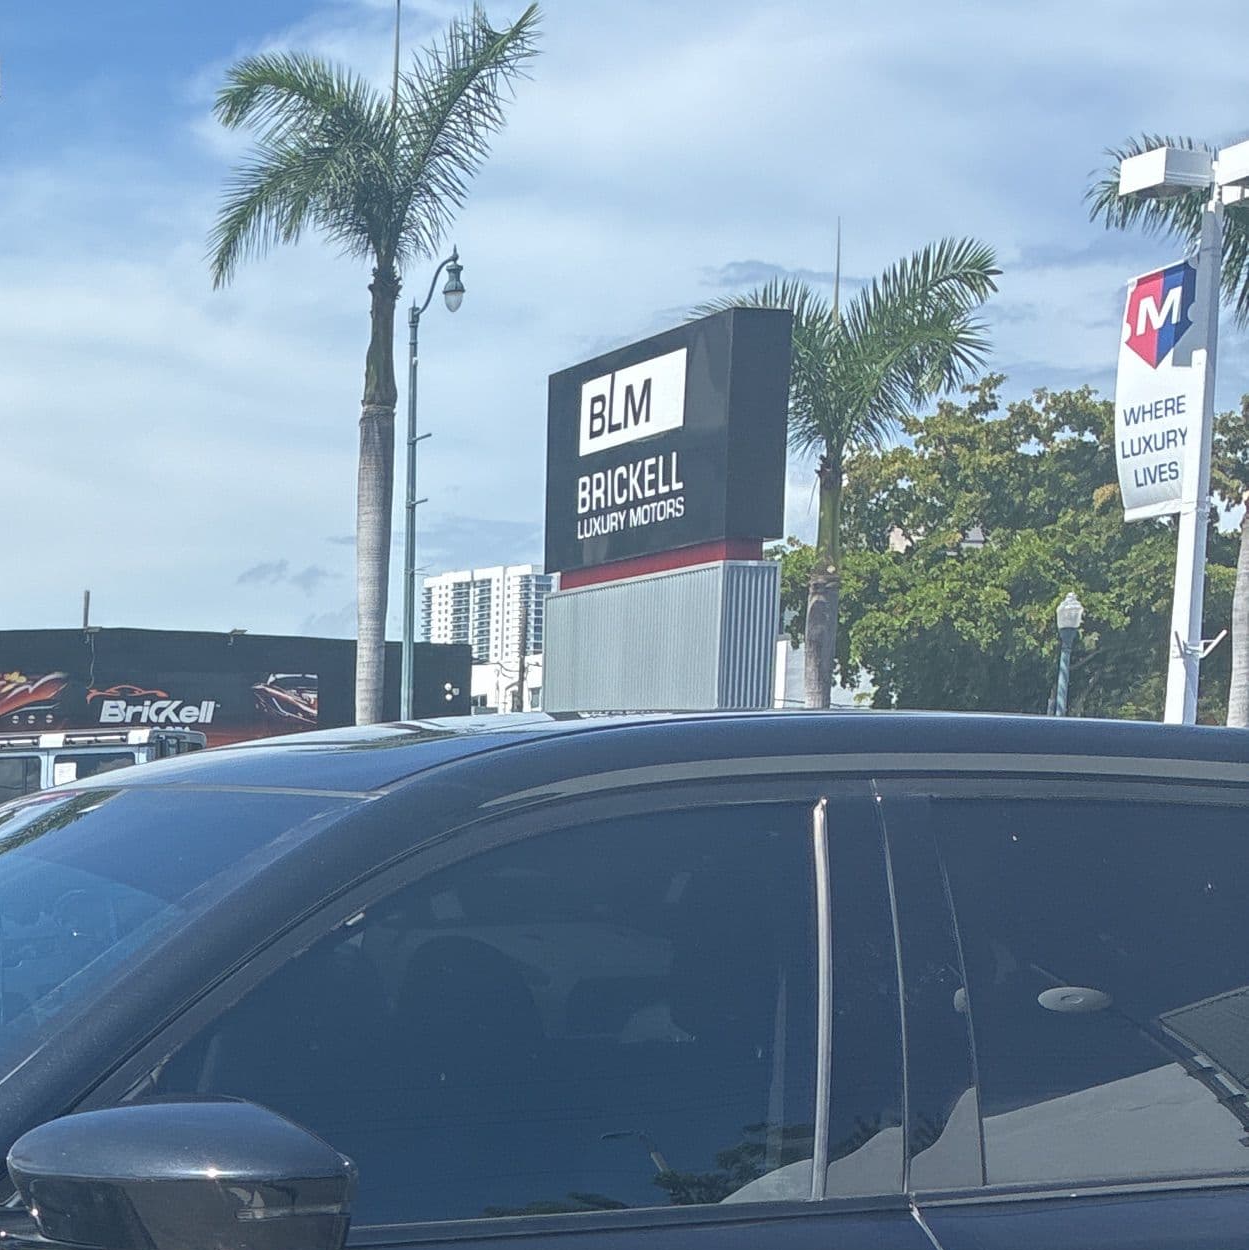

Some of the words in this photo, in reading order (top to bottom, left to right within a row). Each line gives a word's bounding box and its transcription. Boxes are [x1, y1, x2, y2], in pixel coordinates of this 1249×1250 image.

[1136, 286, 1182, 336] M
[589, 371, 652, 440] BLM
[1123, 394, 1187, 427] WHERE
[1121, 426, 1188, 459] LUXURY
[577, 451, 684, 514] BRICKELL
[1134, 461, 1180, 488] LIVES
[577, 509, 627, 540] LUXURY
[629, 496, 685, 528] MOTORS
